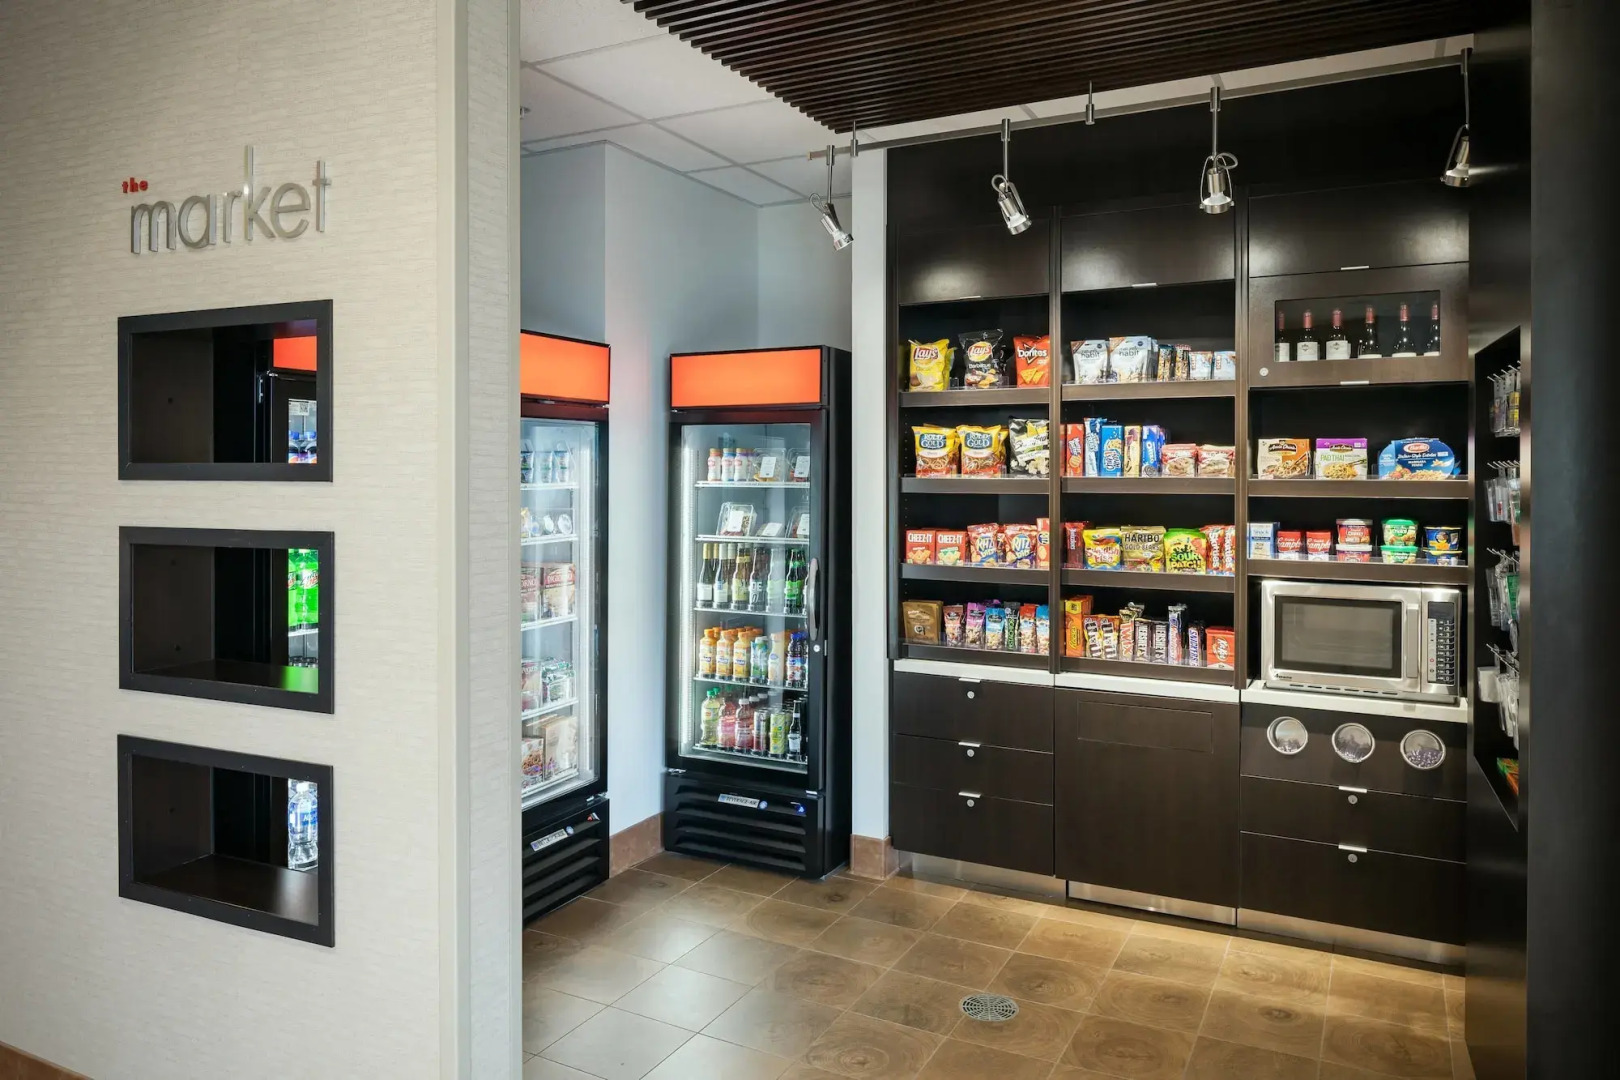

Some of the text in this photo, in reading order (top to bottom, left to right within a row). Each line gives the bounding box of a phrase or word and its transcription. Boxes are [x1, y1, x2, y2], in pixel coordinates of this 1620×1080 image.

[121, 177, 149, 193] the
[131, 145, 332, 254] market
[1125, 533, 1160, 543] HARIBO
[1170, 551, 1199, 562] SOUR
[1190, 630, 1198, 662] SNICKERS
